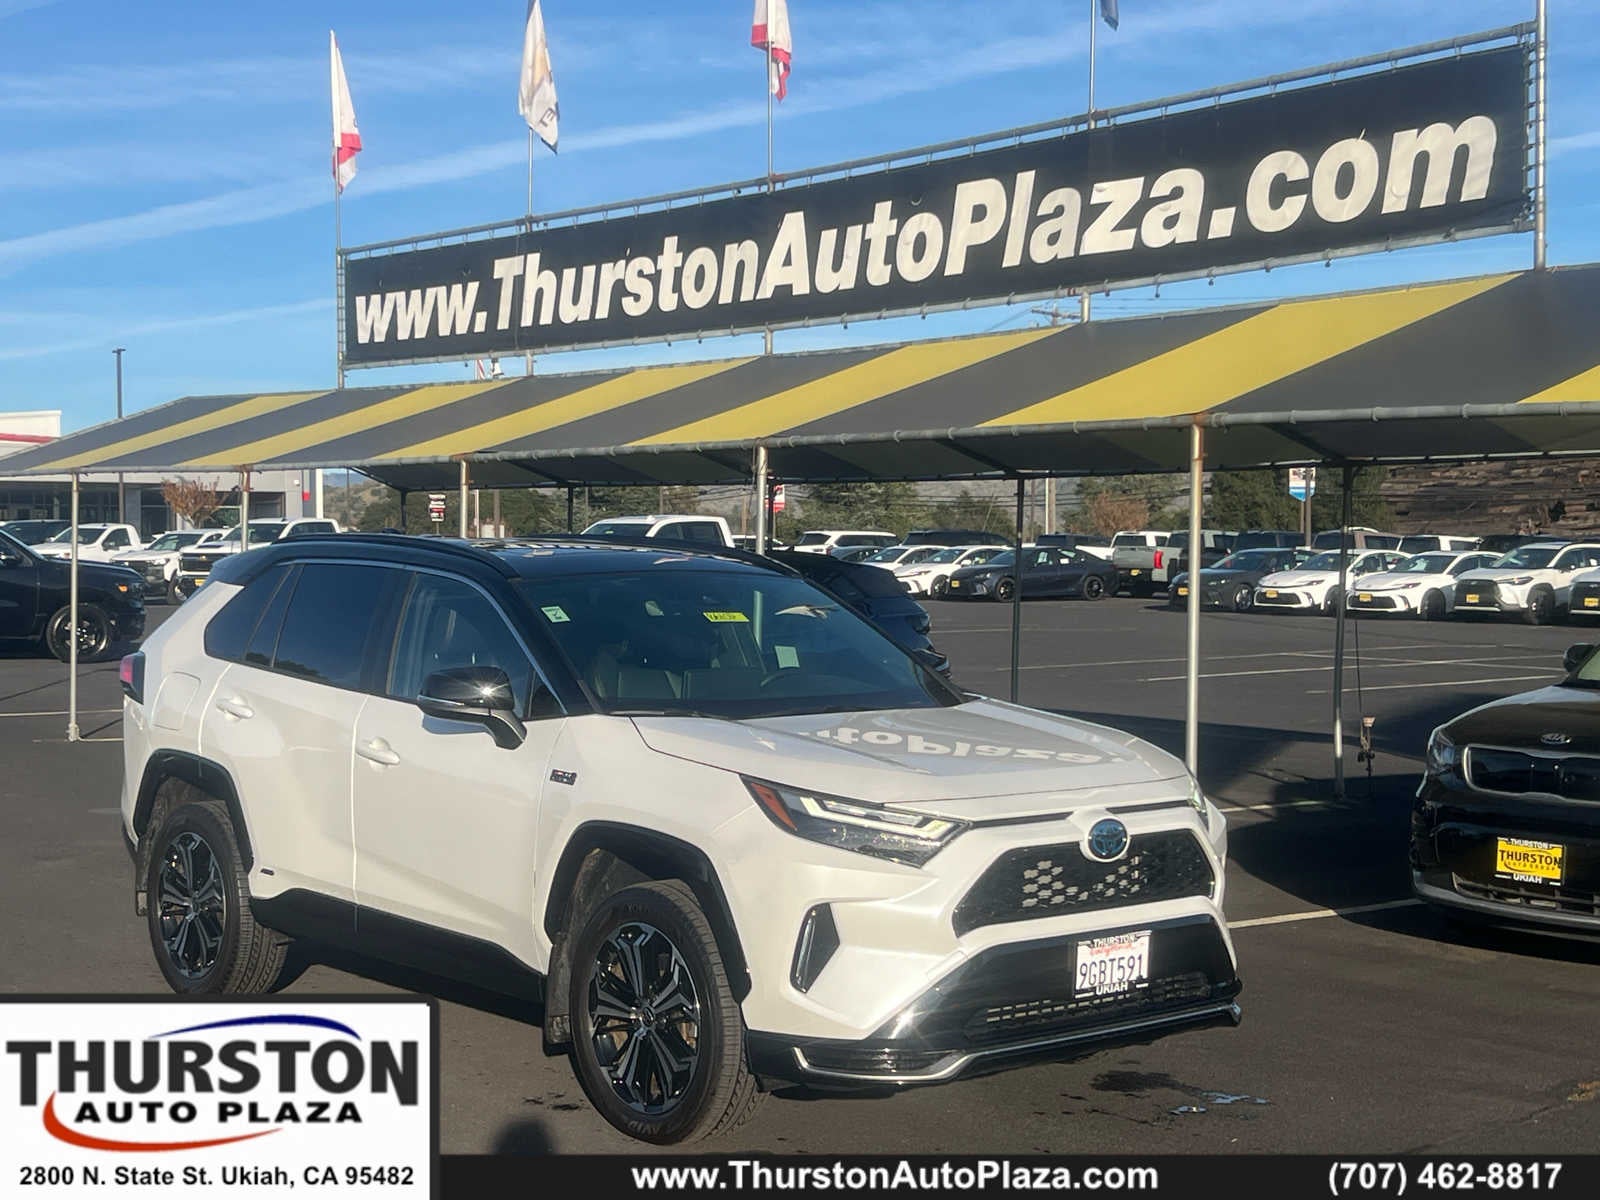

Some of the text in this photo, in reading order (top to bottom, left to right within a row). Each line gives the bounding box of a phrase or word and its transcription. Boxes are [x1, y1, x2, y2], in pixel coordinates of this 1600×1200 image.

[355, 115, 1497, 344] www.ThurstonAutoPlaza.com
[1499, 849, 1561, 868] THURSTON
[1513, 873, 1542, 884] UKIAH
[1079, 954, 1143, 989] 9GBT591
[1096, 981, 1128, 995] UKIAH
